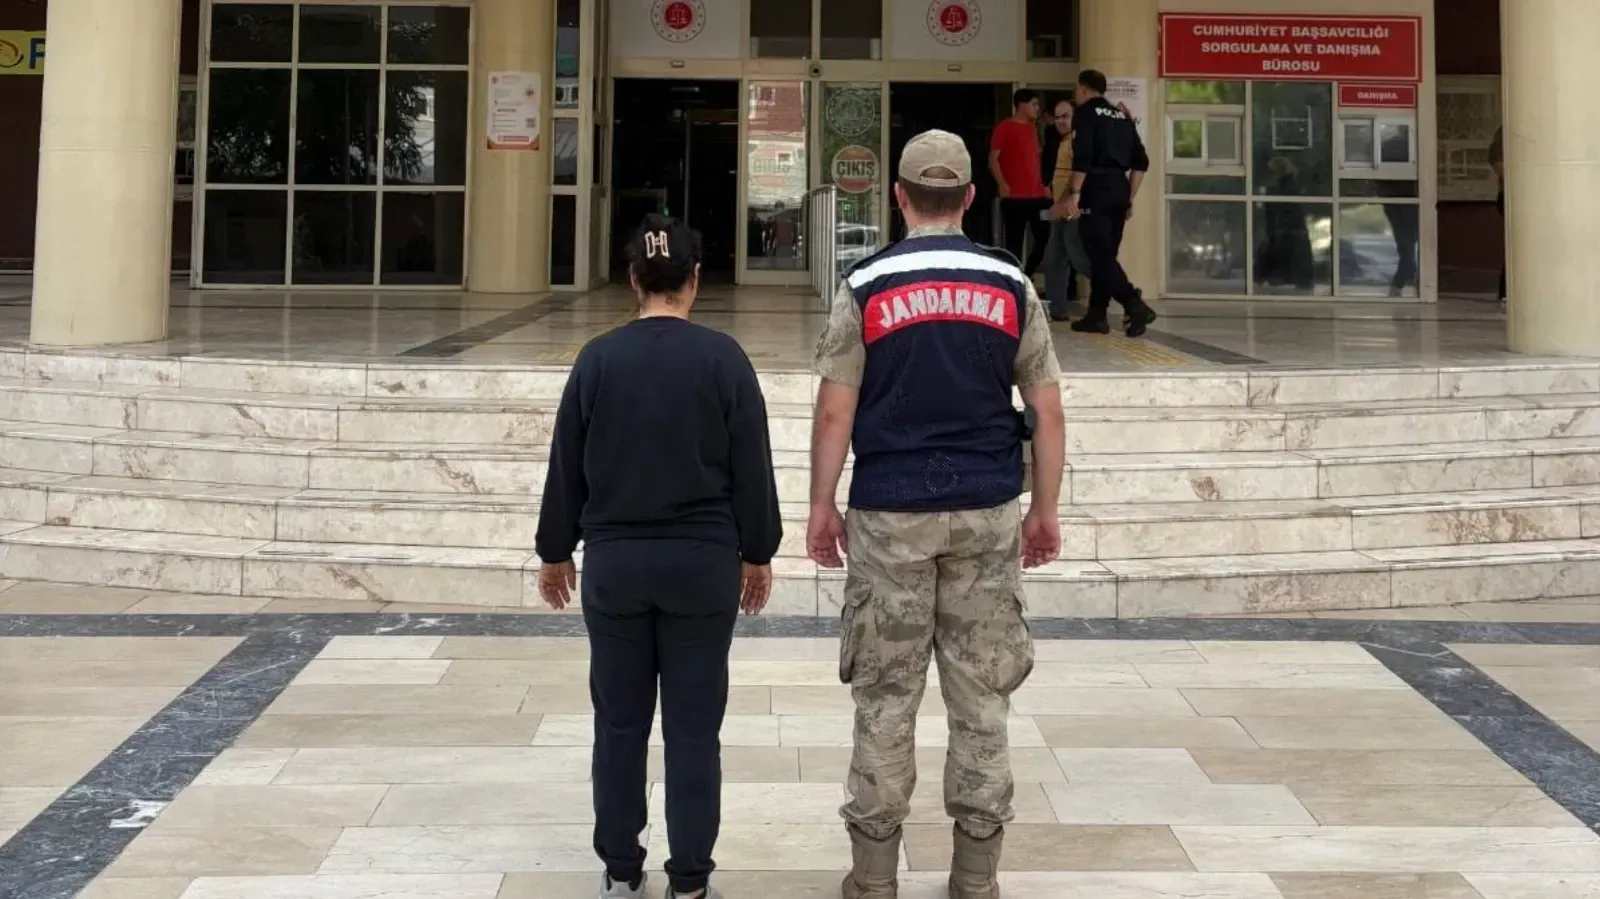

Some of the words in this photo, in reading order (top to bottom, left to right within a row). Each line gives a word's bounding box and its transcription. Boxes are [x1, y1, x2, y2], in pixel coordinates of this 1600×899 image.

[1193, 24, 1287, 37] CUMHURİYET
[1292, 24, 1389, 40] BAŞSAVCILIĞI
[1201, 41, 1290, 54] SORGULAMA
[1294, 43, 1313, 54] VE
[1317, 44, 1381, 57] DANIŞMA
[1262, 58, 1320, 71] BÜROSU
[879, 288, 1005, 328] JANDARMA
